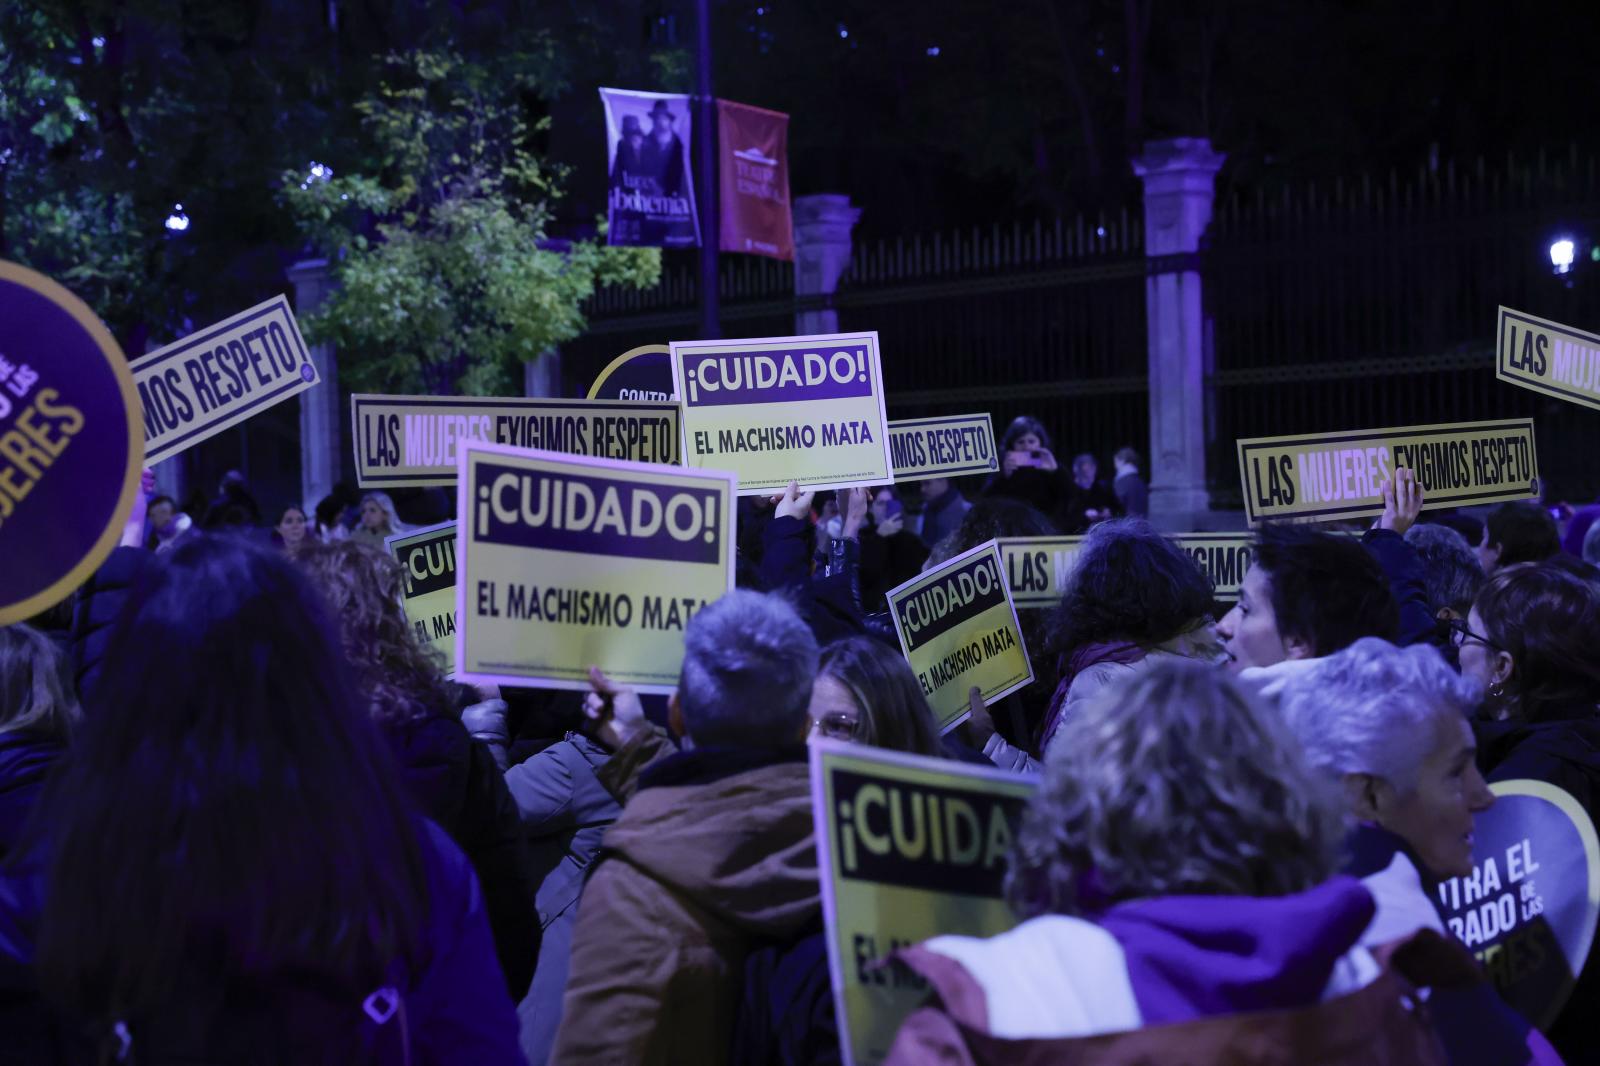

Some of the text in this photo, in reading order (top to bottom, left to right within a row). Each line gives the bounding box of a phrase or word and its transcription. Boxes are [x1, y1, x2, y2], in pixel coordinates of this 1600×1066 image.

[184, 321, 296, 414] RESPETO
[688, 350, 867, 402] ¡CUIDADO!
[1509, 325, 1548, 377] LAS
[6, 363, 39, 397] LAS
[0, 387, 84, 528] ERES
[365, 414, 400, 467] LAS
[593, 416, 671, 463] RESPETO
[694, 420, 873, 454] EL MACHISMO MATA
[926, 426, 988, 464] RESPETO
[1253, 454, 1295, 508] LAS
[1298, 446, 1390, 504] MUJERES
[1471, 436, 1530, 486] RESPETO
[478, 473, 716, 544] ¡CUIDADO!
[402, 539, 456, 593] ¡CUI
[1008, 552, 1048, 592] LAS
[1188, 547, 1249, 586] GIMO
[415, 611, 456, 643] EL MA
[478, 581, 499, 617] EL
[507, 584, 632, 627] MACHISMO
[902, 560, 999, 646] ¡CUIDADO!
[919, 672, 934, 696] EL
[930, 642, 982, 689] MACHISMO
[982, 626, 1015, 659] MATA
[1506, 839, 1540, 884] EL
[1520, 879, 1536, 902] DE
[1521, 896, 1544, 922] LAS
